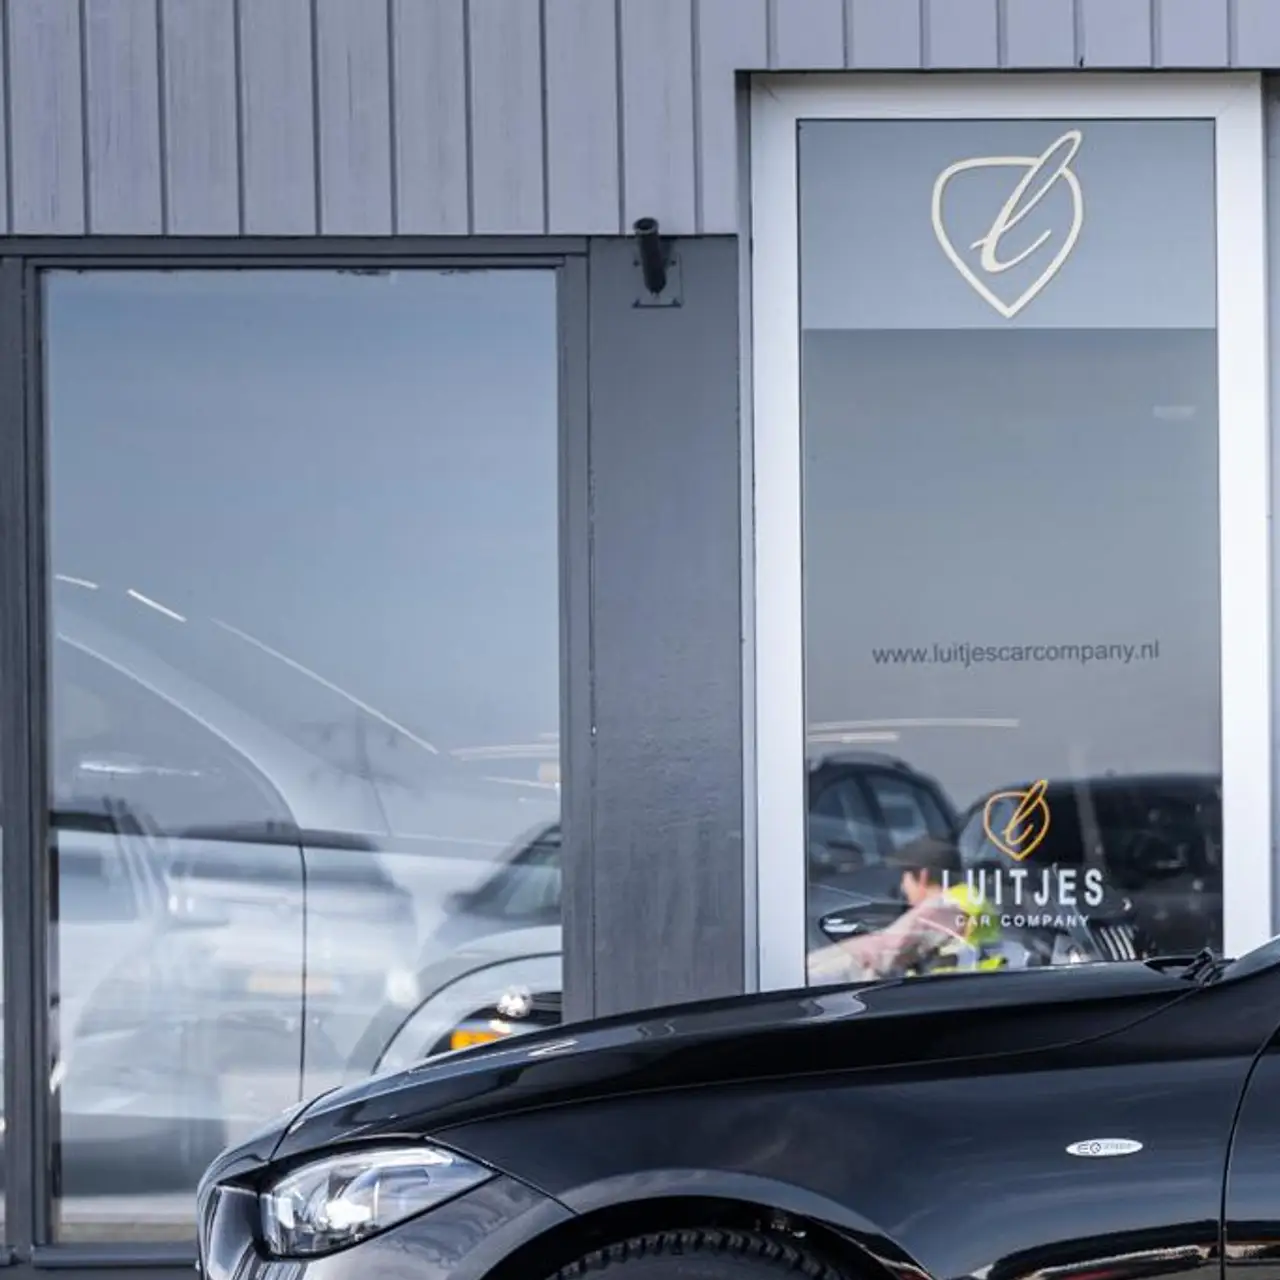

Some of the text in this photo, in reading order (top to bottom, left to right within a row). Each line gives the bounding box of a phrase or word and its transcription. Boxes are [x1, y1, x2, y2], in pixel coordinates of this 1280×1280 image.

[871, 640, 1160, 668] www.luitjescarcompany.nl
[942, 868, 1103, 906] LUITJES
[955, 914, 1089, 928] CAR COMPANY
